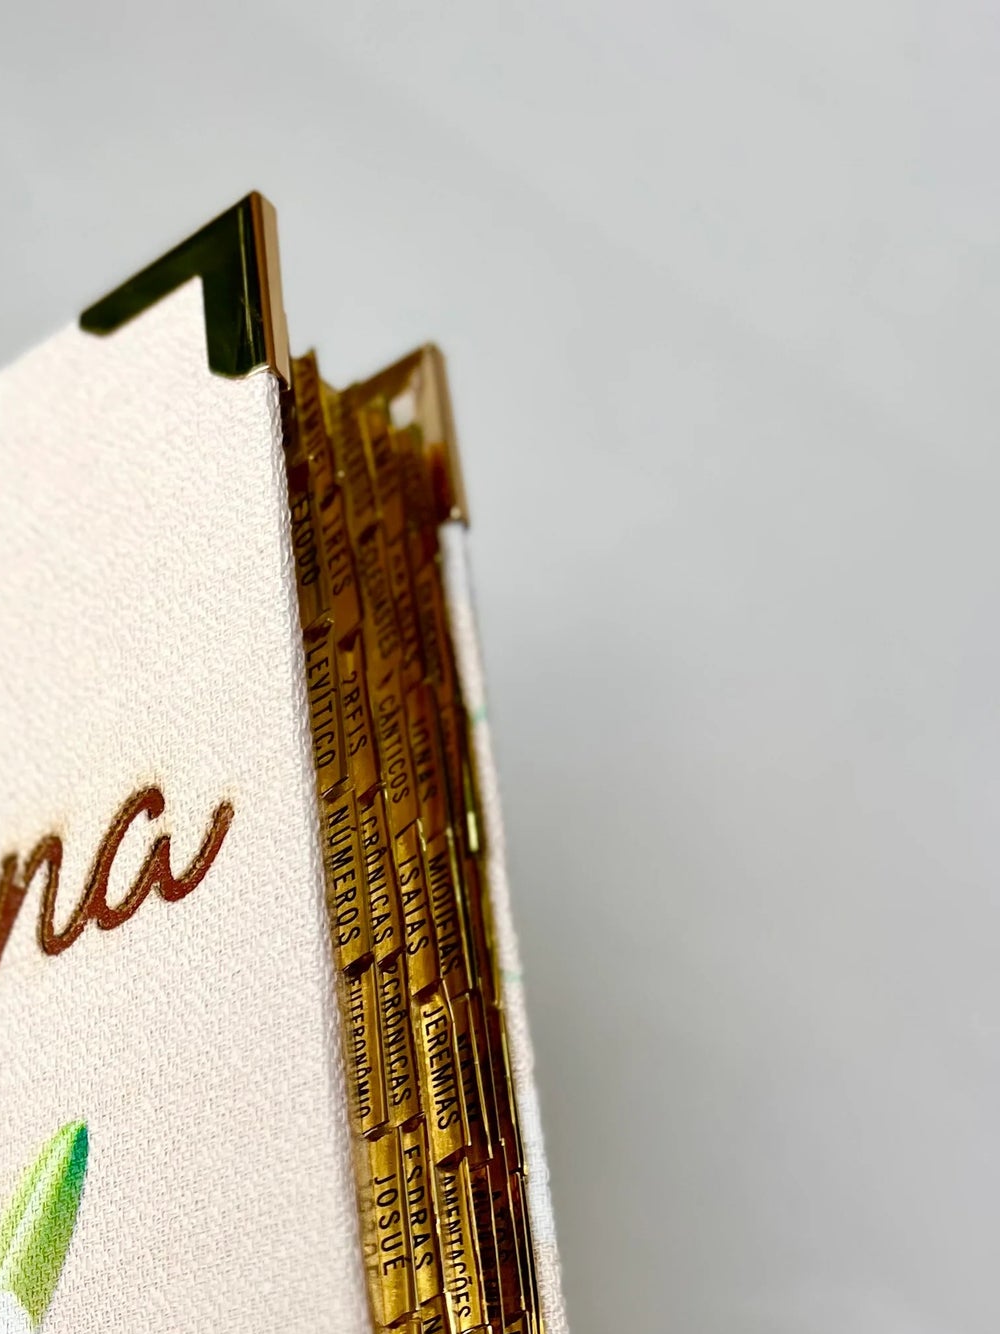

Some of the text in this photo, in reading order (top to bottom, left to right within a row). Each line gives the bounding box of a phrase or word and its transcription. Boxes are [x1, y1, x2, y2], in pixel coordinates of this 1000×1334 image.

[307, 641, 337, 769] LEVÍTICO
[328, 805, 361, 946] NÚMEROS
[382, 963, 412, 1106] 2CRÔNICAS
[422, 1006, 461, 1130] JEREMIAS
[374, 1173, 412, 1275] JOSUÉ
[404, 1144, 434, 1272] ESDRAS
